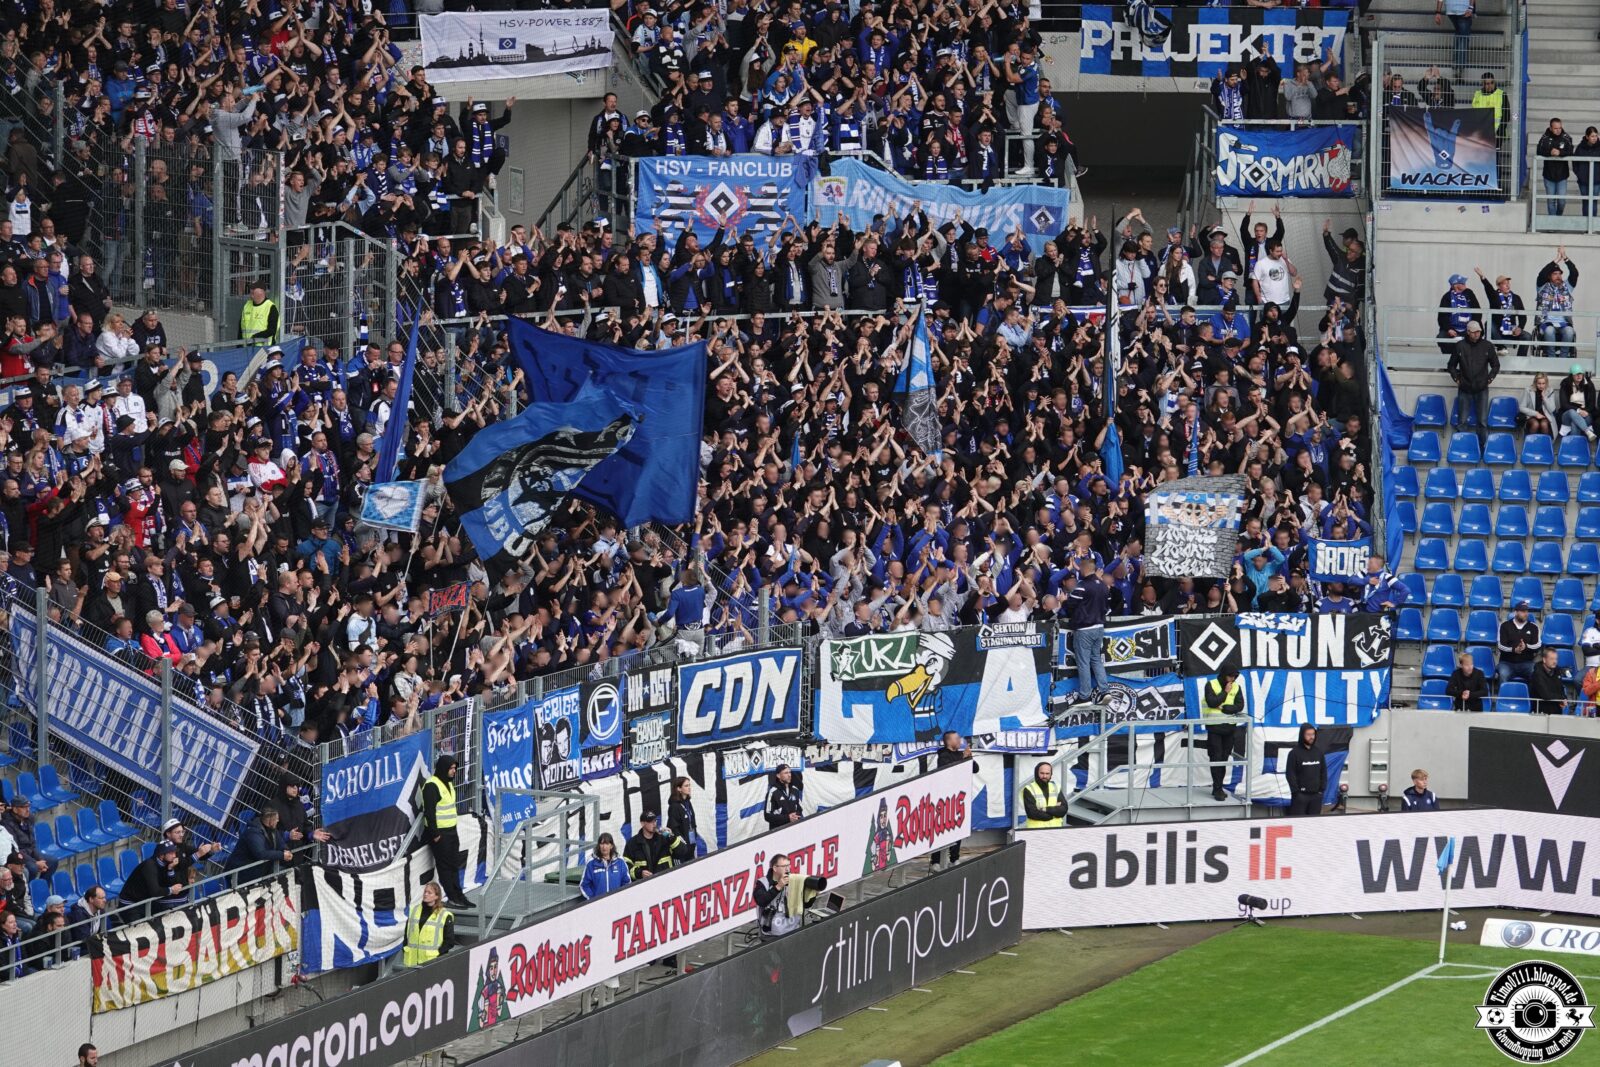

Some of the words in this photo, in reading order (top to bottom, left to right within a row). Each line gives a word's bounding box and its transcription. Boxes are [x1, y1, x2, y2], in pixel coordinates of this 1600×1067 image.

[500, 18, 572, 28] HSV-POWER
[575, 17, 604, 27] 1887
[655, 160, 692, 176] HSV
[708, 161, 793, 178] FANCLUB
[1401, 171, 1490, 186] WACKEN
[981, 634, 1042, 648] STADIONVERBOT
[993, 623, 1026, 634] SEKTION
[1239, 613, 1346, 667] IRON
[18, 620, 242, 806] NORDHAUSEN
[650, 668, 672, 707] OST
[681, 655, 798, 736] CDN
[325, 752, 404, 804] SCHOLLI
[895, 791, 967, 849] Rothaus
[1069, 830, 1229, 890] abilis
[611, 835, 840, 964] TANNENZÄFLE
[1238, 897, 1292, 917] gup
[811, 876, 1010, 1004] stil.impulse
[506, 934, 592, 1002] Rothaus
